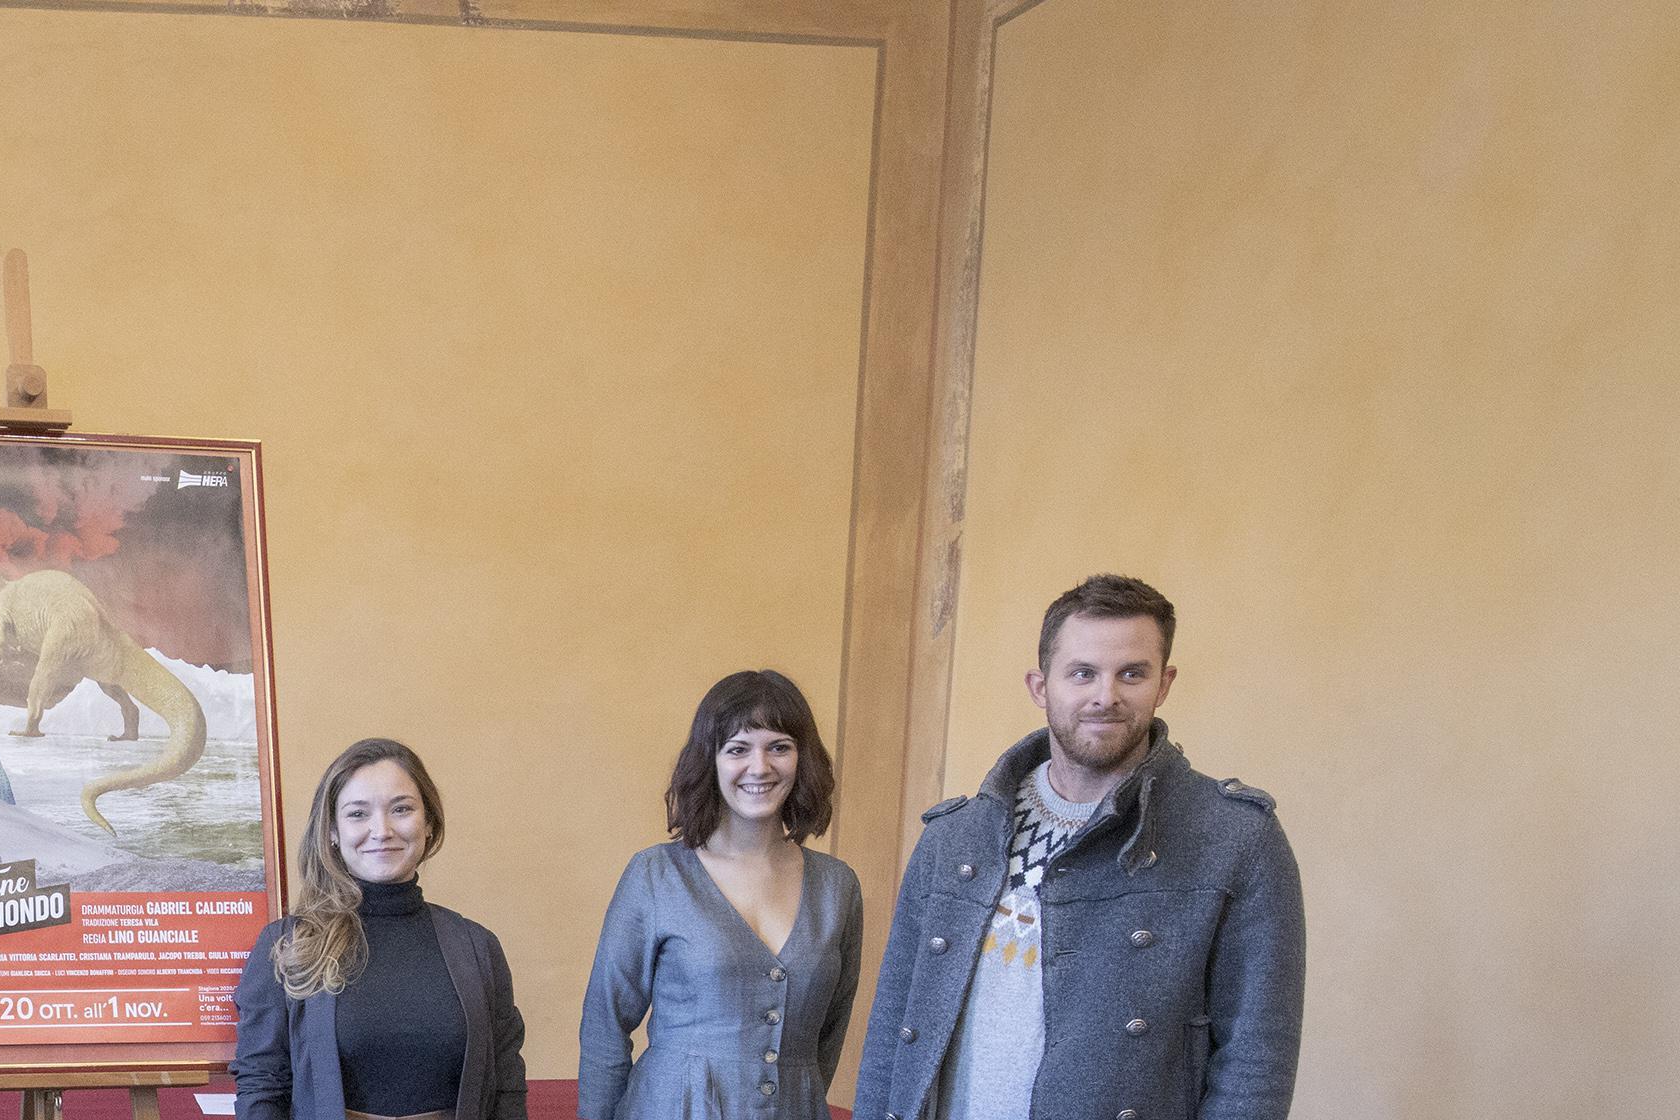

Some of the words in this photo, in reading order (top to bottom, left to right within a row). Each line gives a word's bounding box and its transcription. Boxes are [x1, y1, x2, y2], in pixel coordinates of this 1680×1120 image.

[202, 475, 228, 487] HERA
[81, 904, 144, 915] DRAMMATURGIA
[146, 901, 192, 915] GABRIEL
[195, 898, 253, 915] CALDERÓN
[82, 918, 118, 927] TRADUZIONE
[120, 918, 143, 927] TERESA
[145, 918, 159, 927] VILA
[82, 933, 106, 944] REGIA
[108, 930, 134, 944] LINO
[137, 930, 199, 943] GUANCIALE
[9, 953, 37, 961] VITTORIA
[79, 952, 112, 961] CRISTIANA
[158, 952, 182, 960] JACOPO
[208, 951, 229, 960] GIULIA
[198, 994, 215, 1002] Una
[216, 994, 234, 1002] volt
[0, 997, 34, 1020] 20
[39, 1003, 78, 1019] OTT.
[124, 1002, 168, 1018] NOV.
